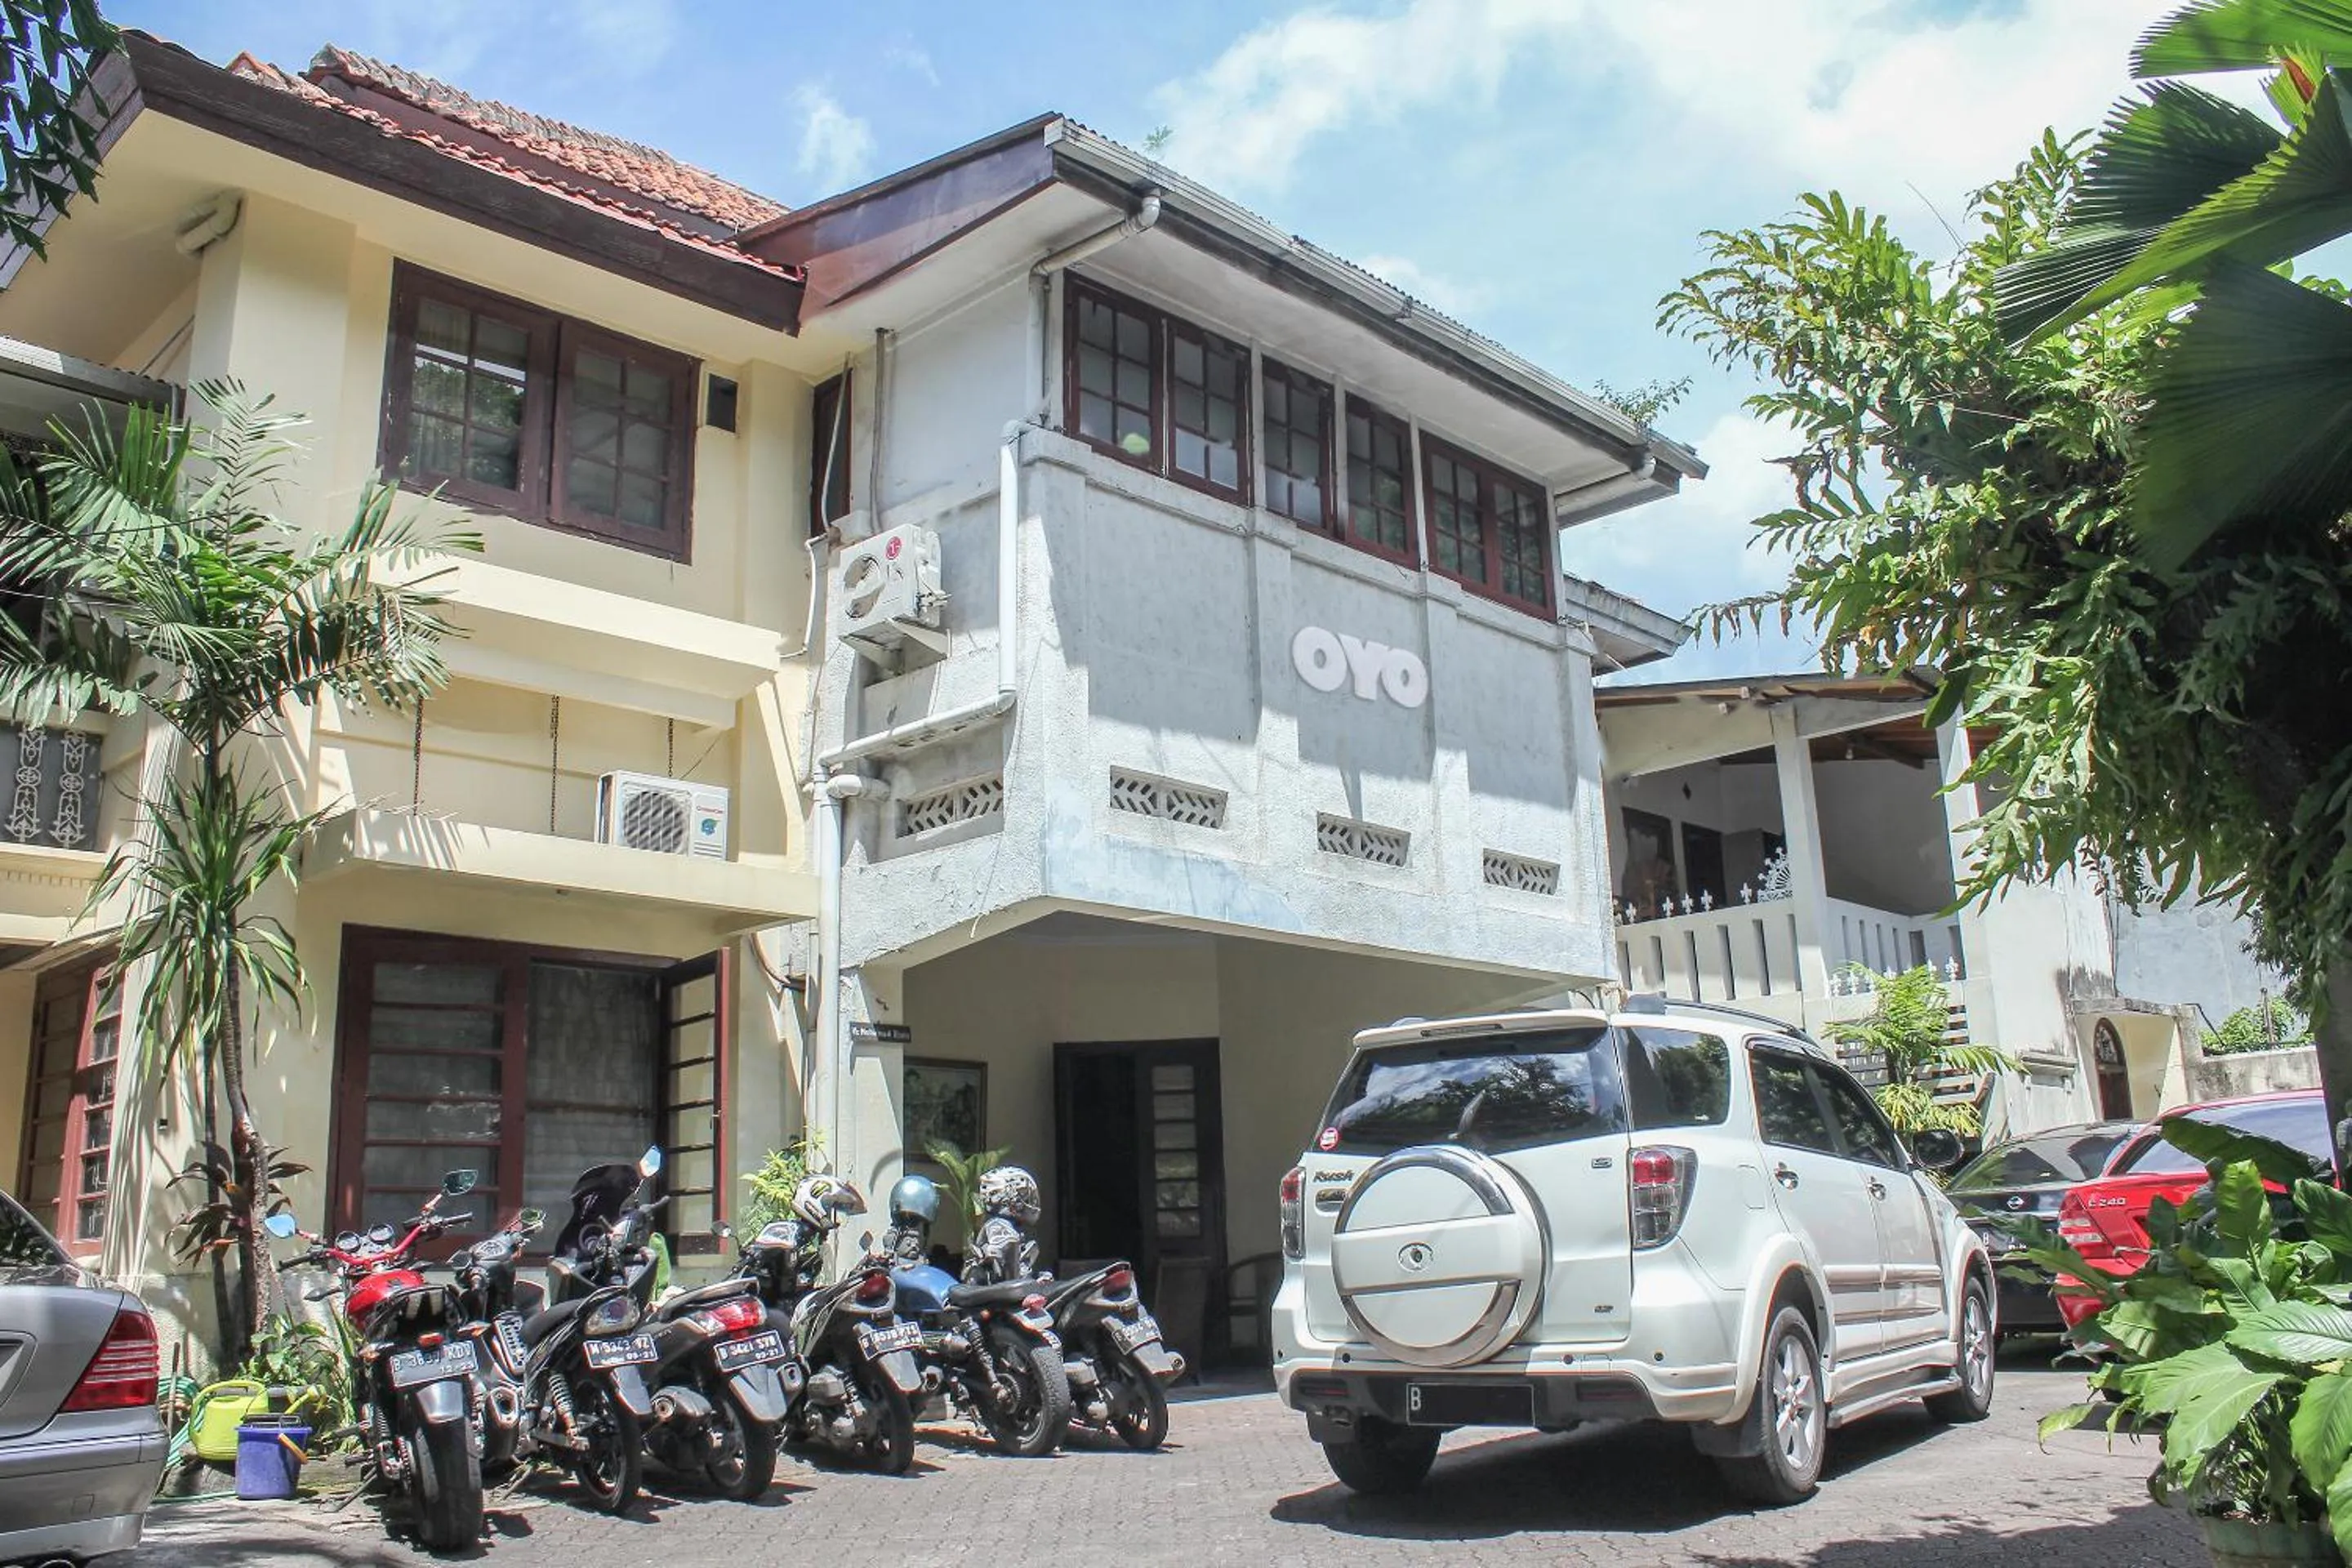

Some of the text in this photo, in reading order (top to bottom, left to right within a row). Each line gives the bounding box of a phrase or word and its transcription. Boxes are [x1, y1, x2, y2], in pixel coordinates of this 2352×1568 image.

[1292, 626, 1428, 708] OYO
[2099, 1197, 2127, 1207] 240
[1410, 1387, 1421, 1411] B
